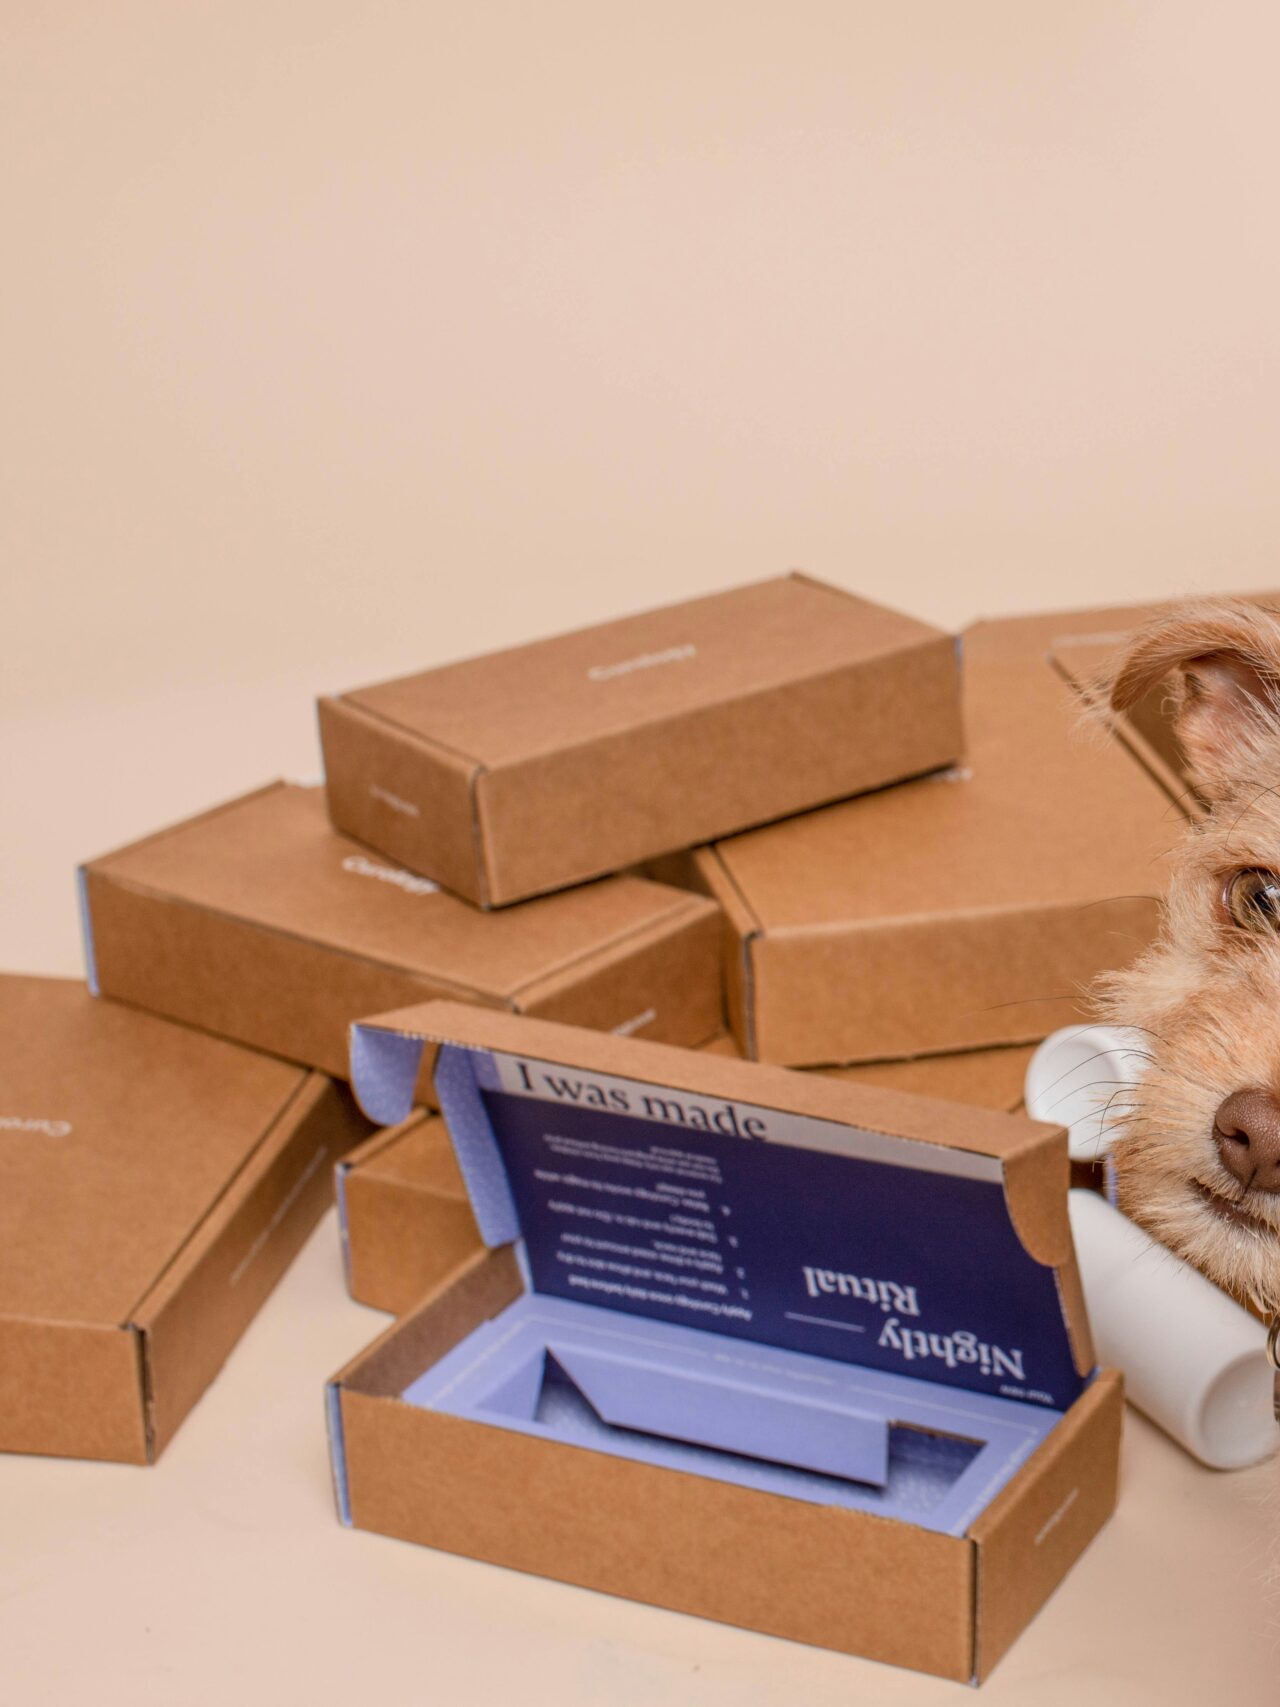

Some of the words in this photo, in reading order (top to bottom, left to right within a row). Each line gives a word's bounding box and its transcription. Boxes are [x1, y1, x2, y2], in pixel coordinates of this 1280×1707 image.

[514, 1061, 535, 1092] I
[542, 1072, 633, 1112] was
[640, 1093, 768, 1141] made
[802, 1266, 921, 1316] Ritual
[878, 1317, 1026, 1381] Nightly
